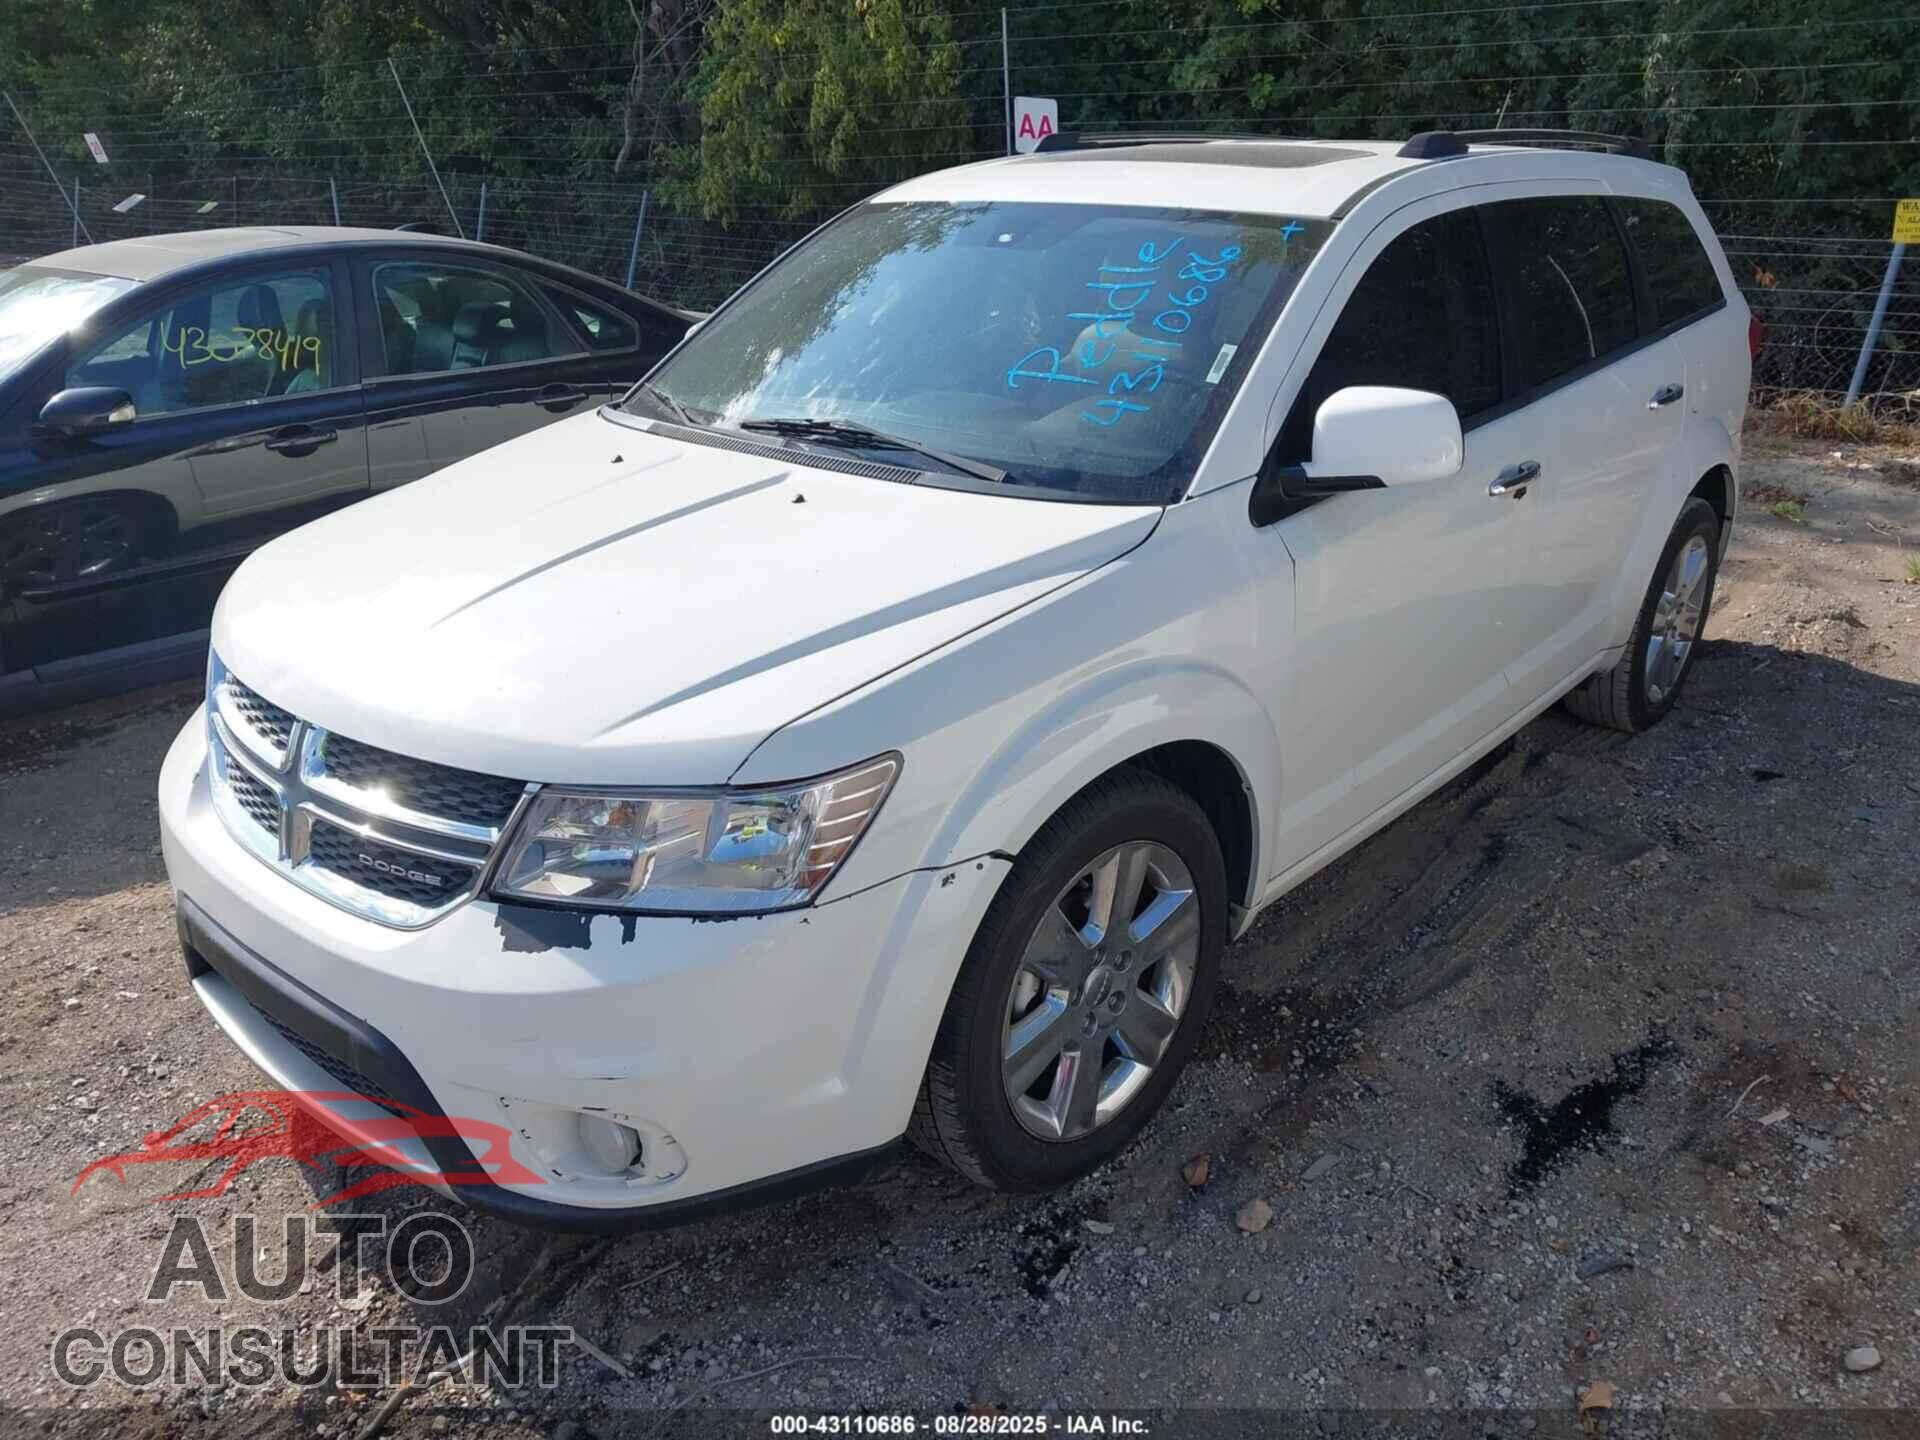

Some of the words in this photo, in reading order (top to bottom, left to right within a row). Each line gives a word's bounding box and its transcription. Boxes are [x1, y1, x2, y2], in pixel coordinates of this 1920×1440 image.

[1018, 113, 1053, 139] AA
[1007, 236, 1185, 388] Peddle
[1080, 245, 1241, 426] 43110686
[160, 324, 322, 376] 43078419
[359, 853, 442, 887] DODGE
